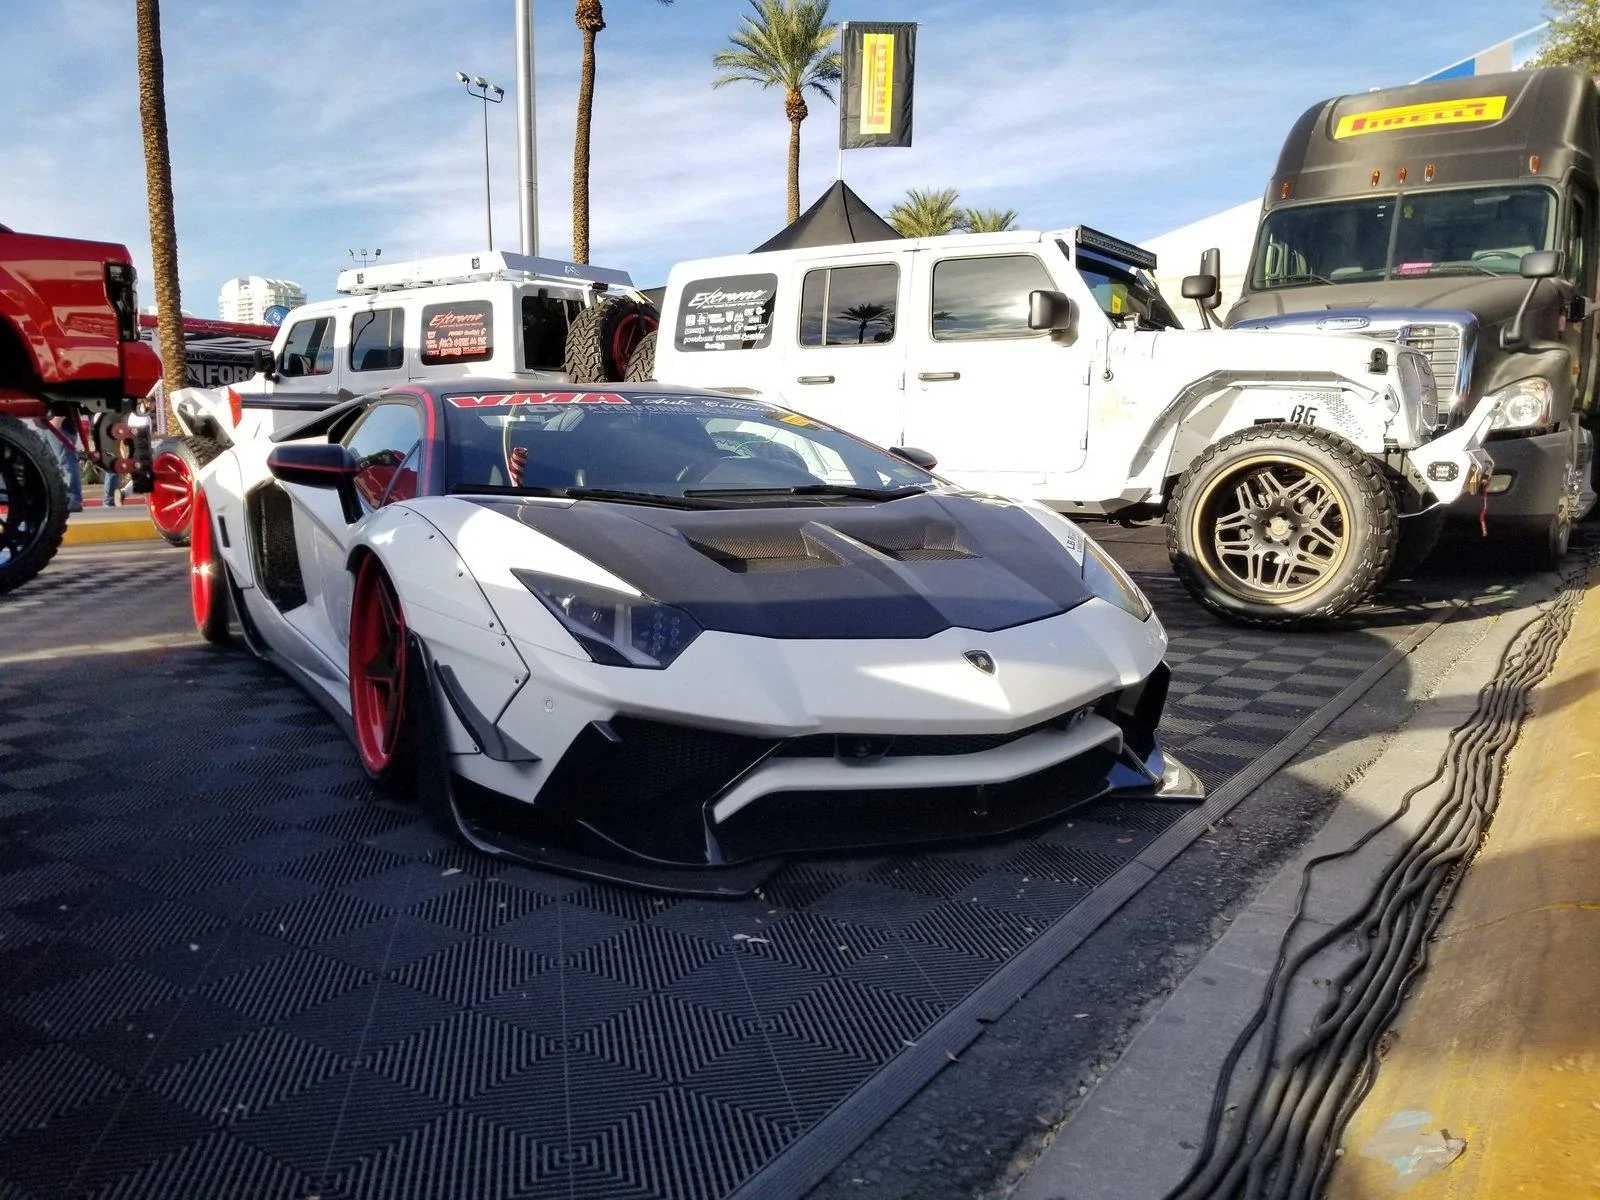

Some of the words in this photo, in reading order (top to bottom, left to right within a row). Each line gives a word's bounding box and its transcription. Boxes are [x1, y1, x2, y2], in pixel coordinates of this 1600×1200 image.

[867, 43, 887, 124] PIRELLI
[1351, 102, 1487, 131] PIRELLI
[447, 391, 631, 408] VMA
[1290, 404, 1318, 425] BG
